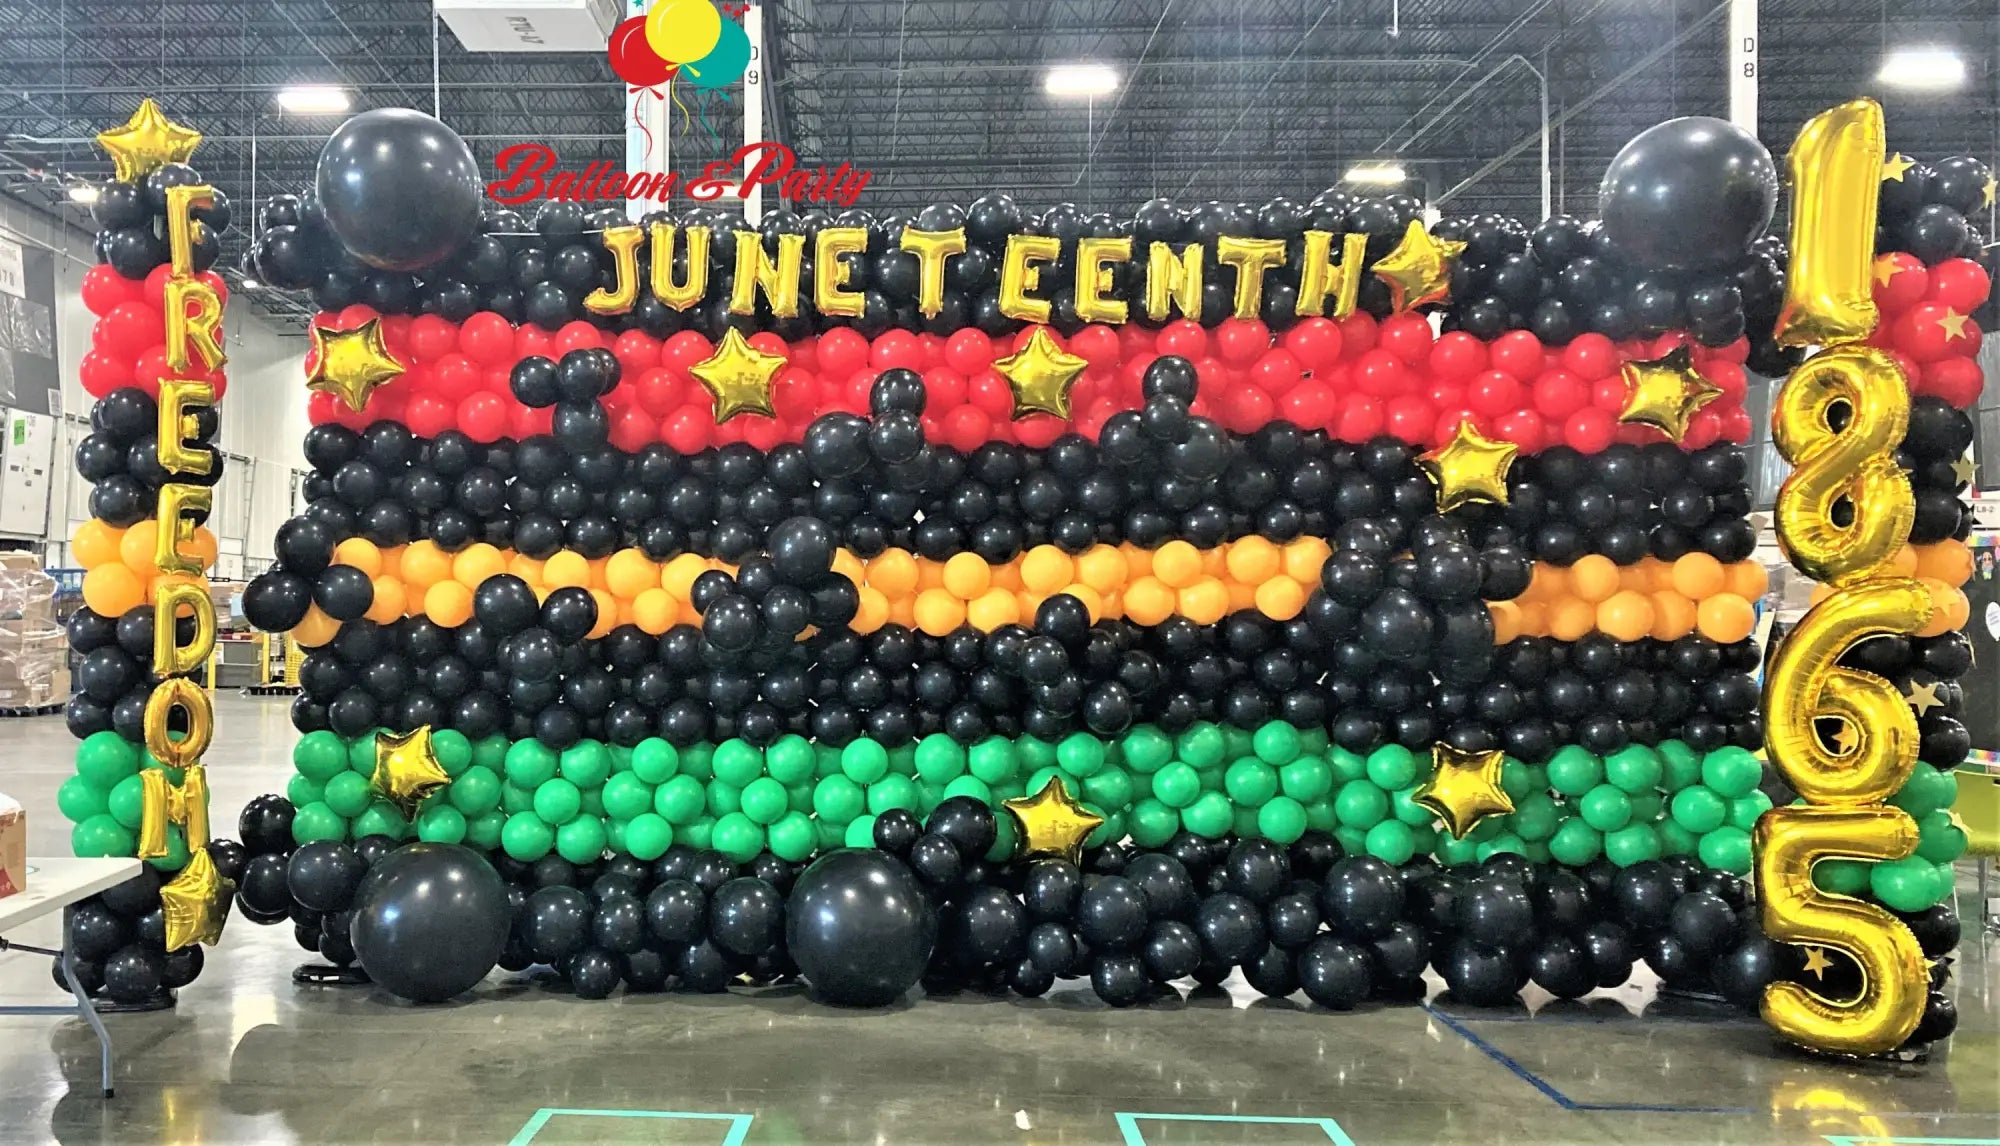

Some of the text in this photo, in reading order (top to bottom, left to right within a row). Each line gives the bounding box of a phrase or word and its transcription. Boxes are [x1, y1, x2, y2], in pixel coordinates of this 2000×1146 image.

[138, 184, 228, 860] FREEDOM
[583, 219, 1369, 324] JUNETEENTH
[1753, 96, 1933, 1058] 1865
